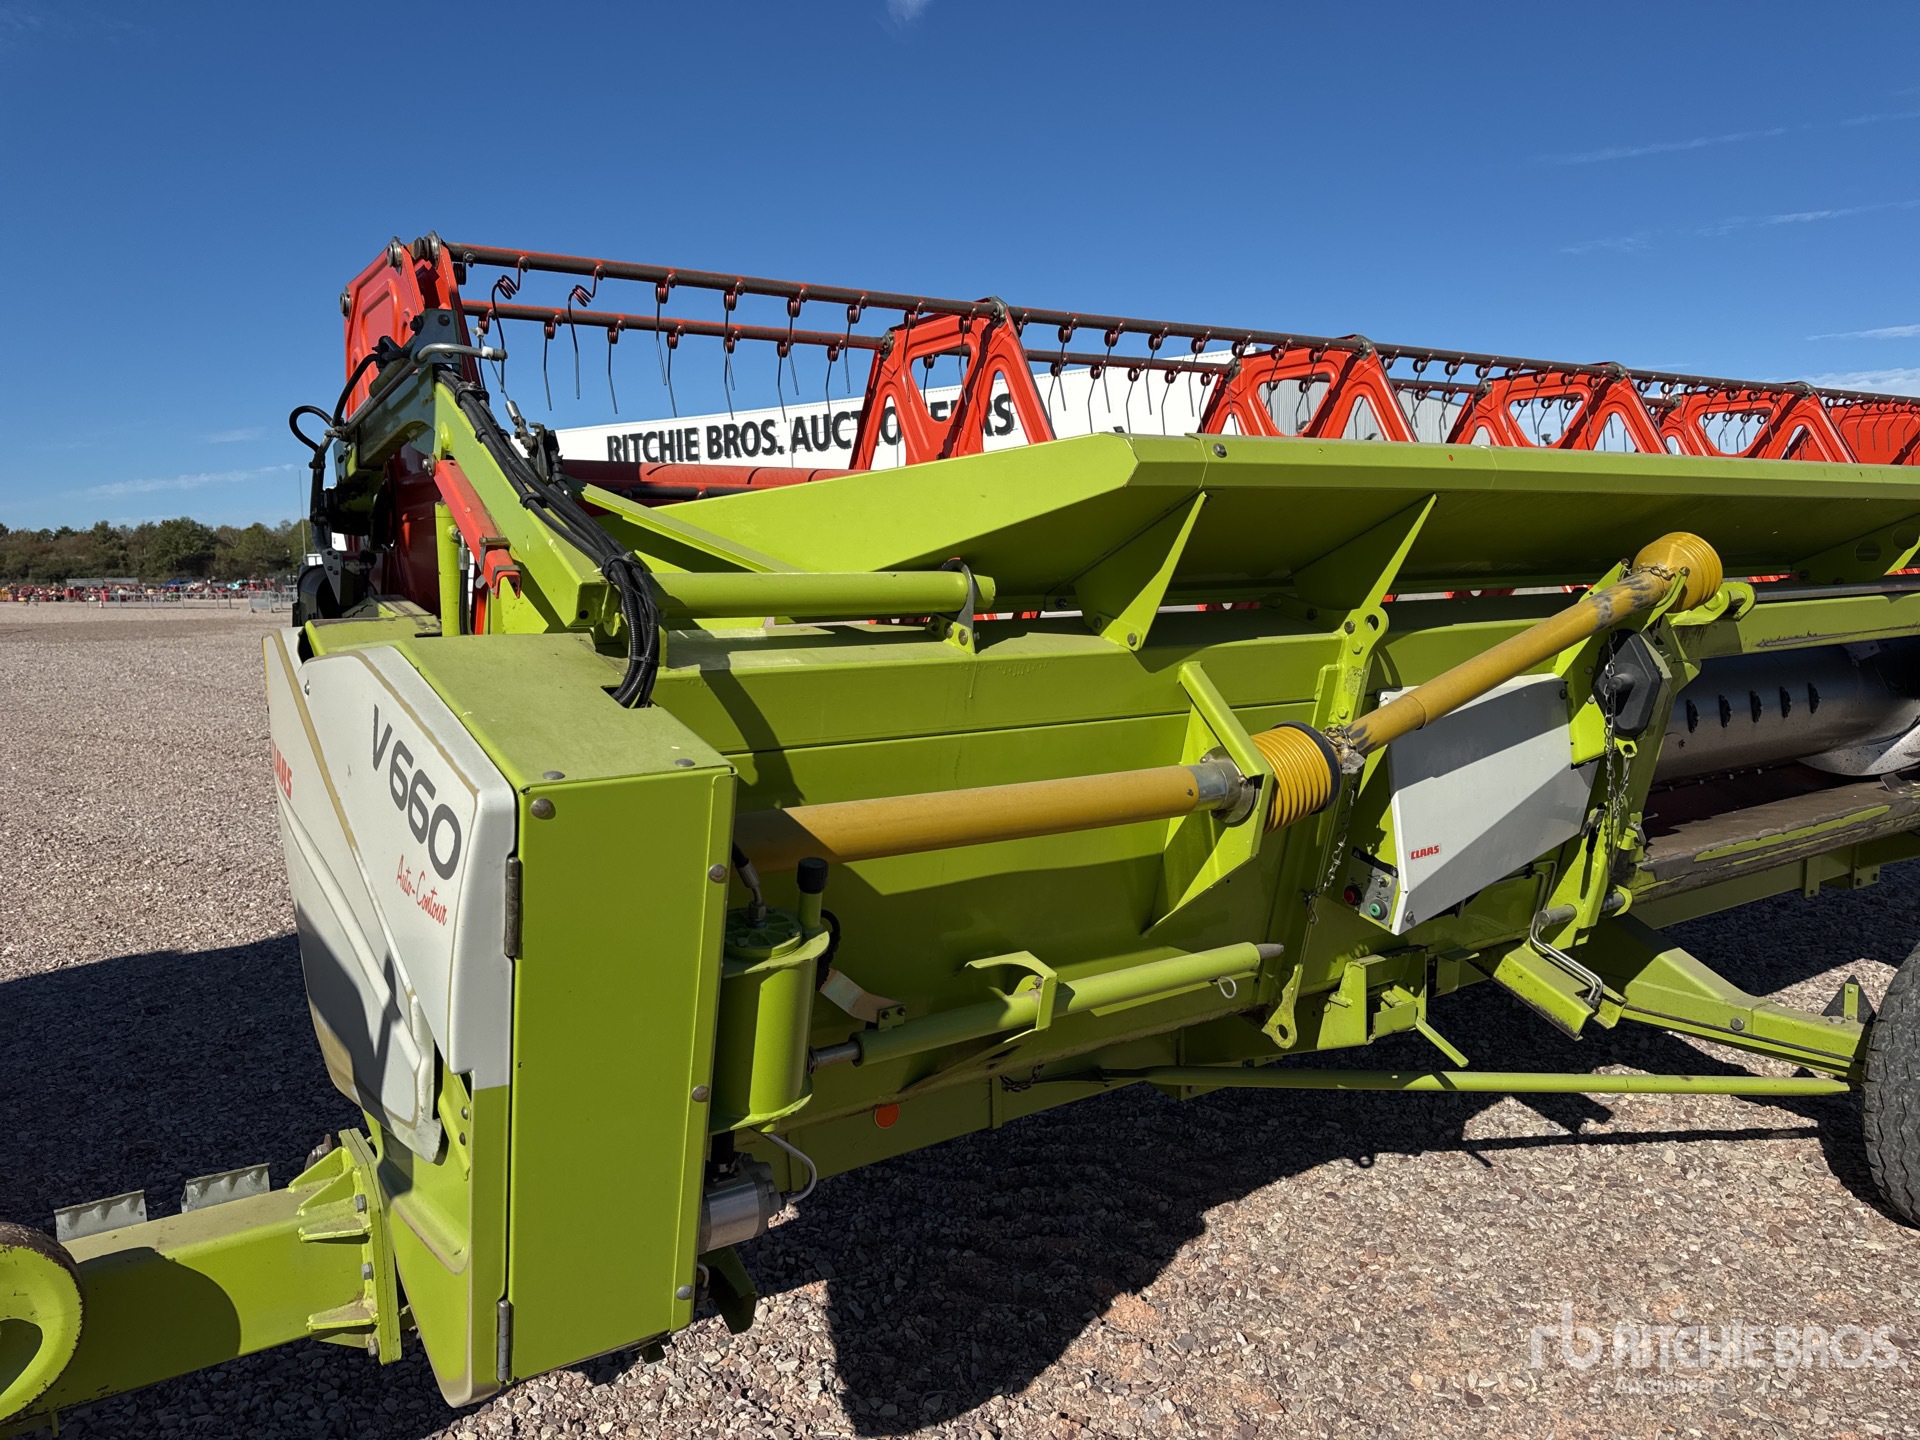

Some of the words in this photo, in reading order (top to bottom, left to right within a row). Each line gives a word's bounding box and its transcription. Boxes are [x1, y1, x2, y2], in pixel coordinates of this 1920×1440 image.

[607, 427, 699, 463] RITCHIE
[706, 419, 785, 460] BROS.
[371, 703, 462, 880] V660
[1410, 845, 1440, 860] CLAAS
[395, 853, 448, 926] Auto-Contour
